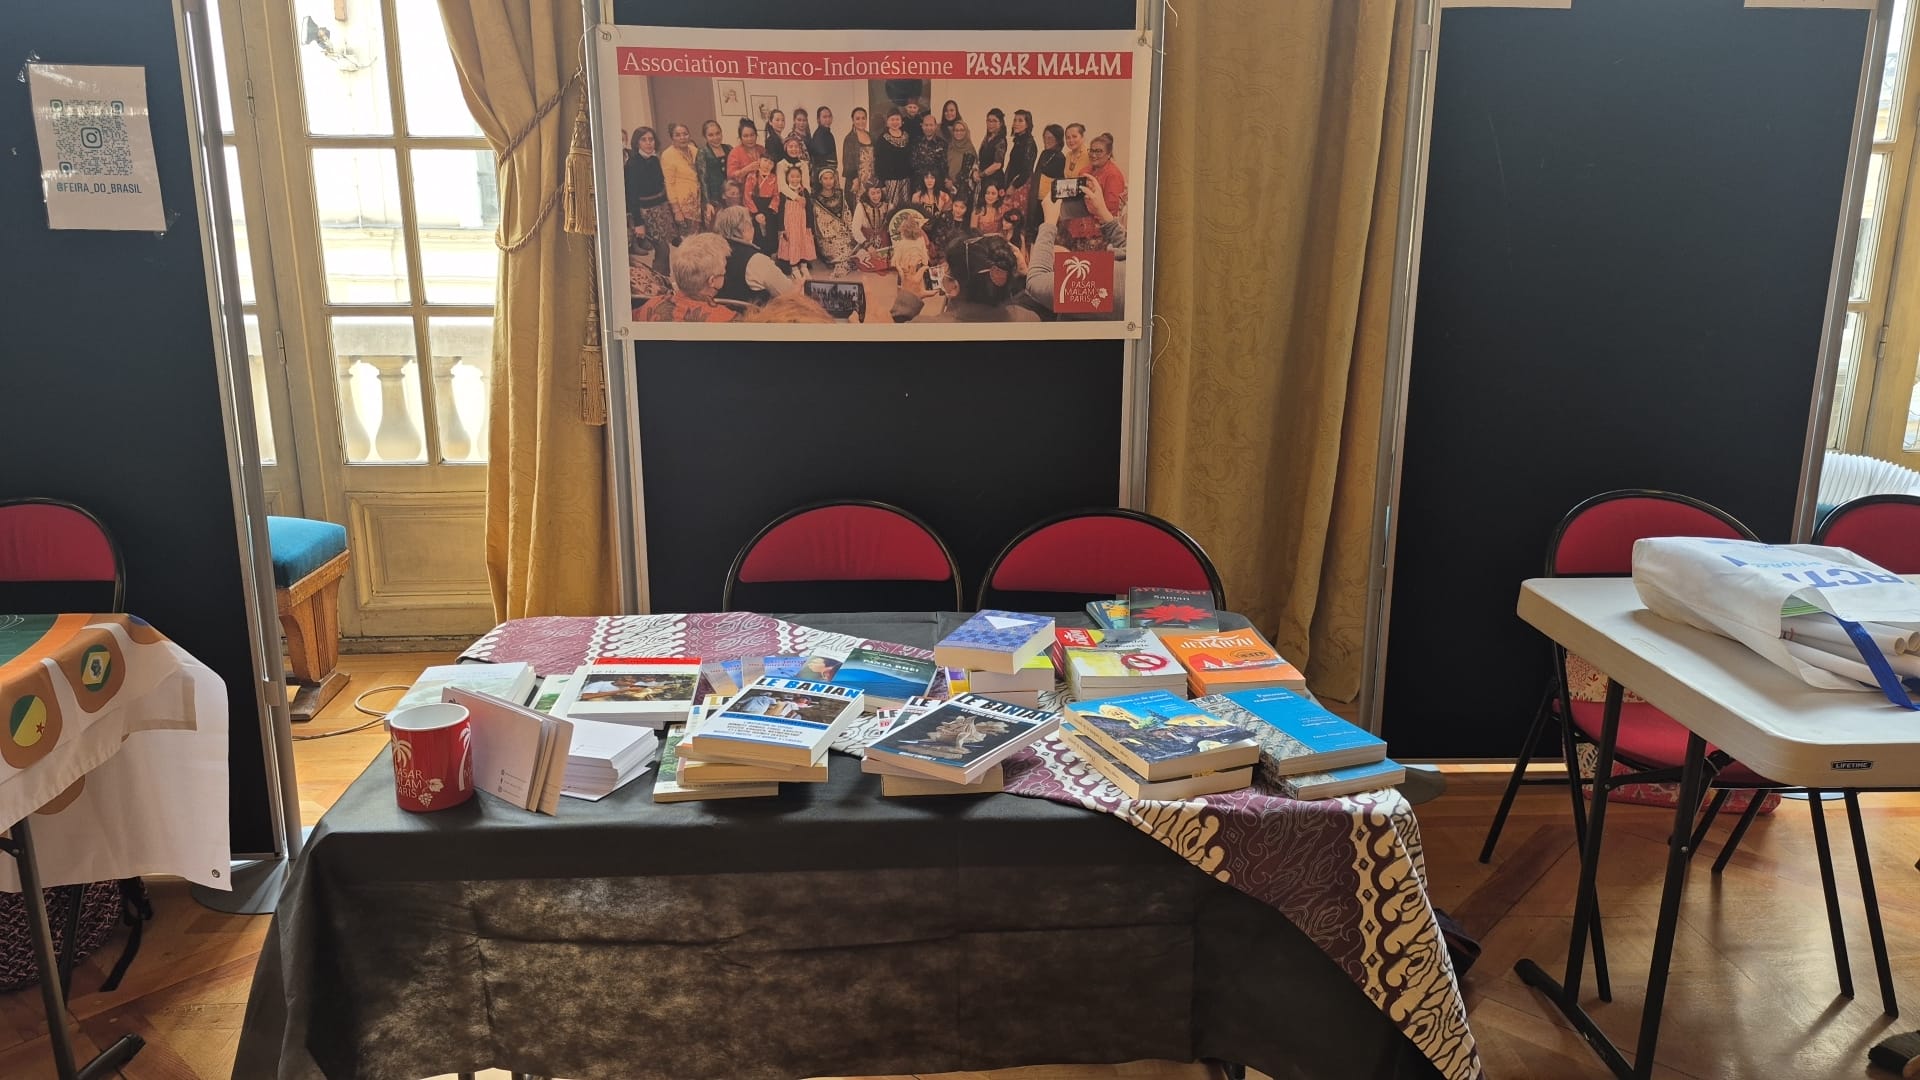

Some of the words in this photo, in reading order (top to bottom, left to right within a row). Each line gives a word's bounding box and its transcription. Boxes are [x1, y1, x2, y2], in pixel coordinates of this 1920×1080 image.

[622, 52, 740, 74] Association
[746, 55, 954, 77] Franco-Indonésienne
[966, 52, 1032, 76] PASAR
[1037, 52, 1122, 76] MALAM
[1071, 280, 1096, 288] PASAR
[1065, 288, 1095, 296] MALAM
[1070, 295, 1091, 303] PARIS
[755, 677, 776, 687] LE
[784, 680, 861, 699] BANIAN
[909, 696, 932, 707] LE
[956, 694, 977, 707] LE
[979, 697, 1055, 721] BANIAN
